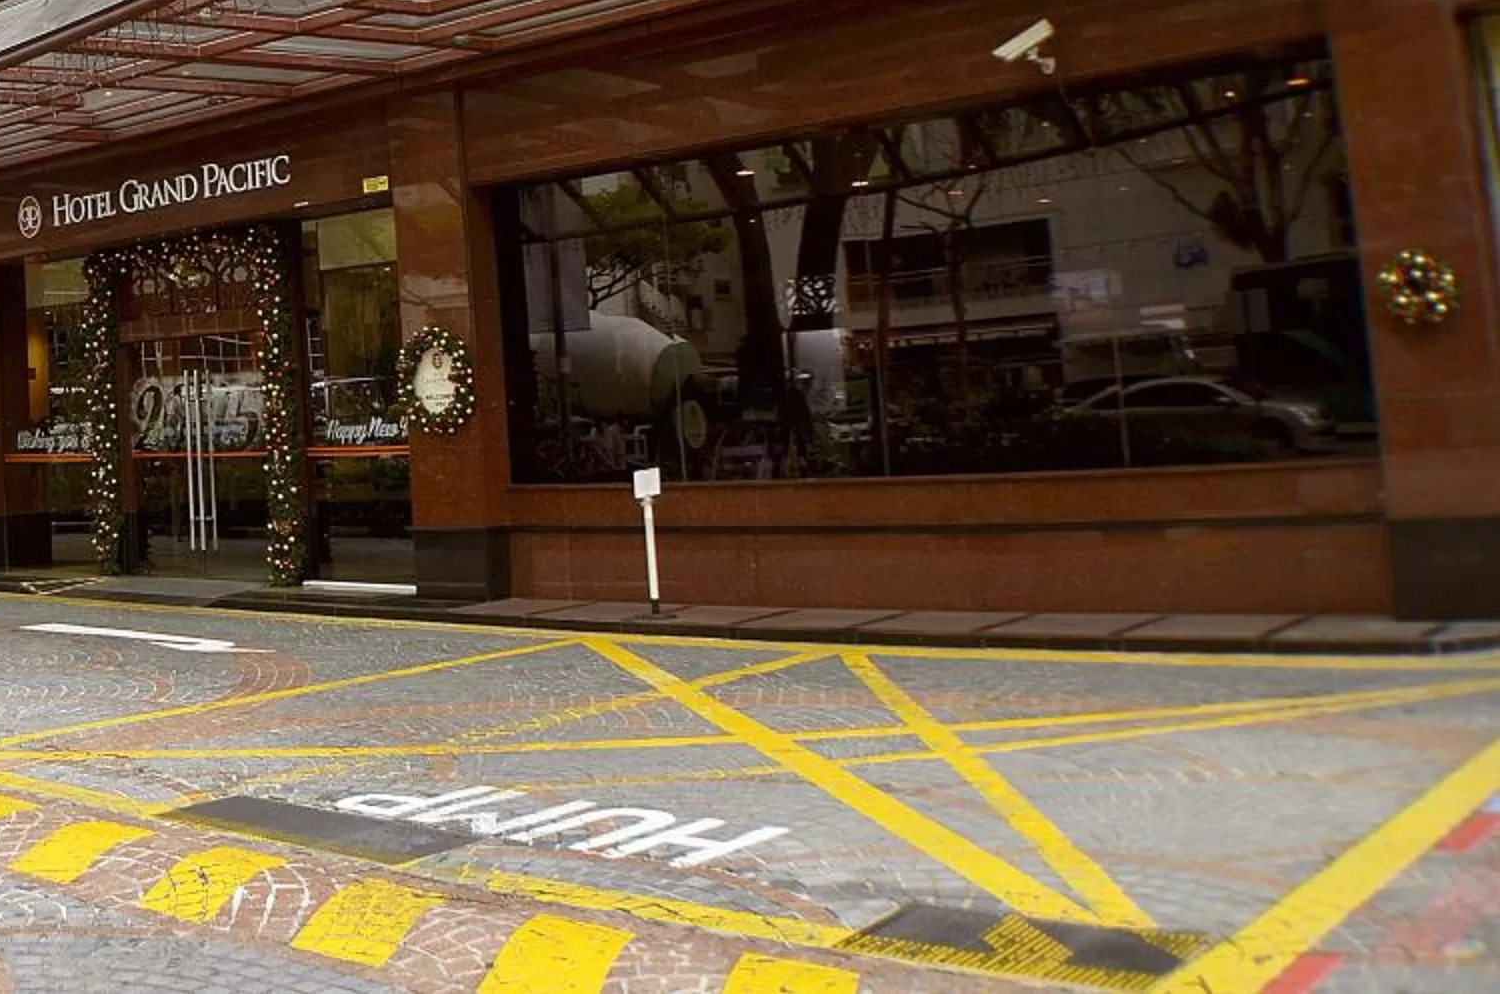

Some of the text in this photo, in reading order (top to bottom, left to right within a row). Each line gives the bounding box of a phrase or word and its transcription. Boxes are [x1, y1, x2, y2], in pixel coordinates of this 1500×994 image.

[52, 193, 116, 227] HOTEL
[119, 173, 198, 213] GRAND
[201, 155, 291, 199] PACIFIC
[327, 418, 367, 445] Happy
[369, 415, 400, 438] New
[335, 785, 789, 868] HUMP
